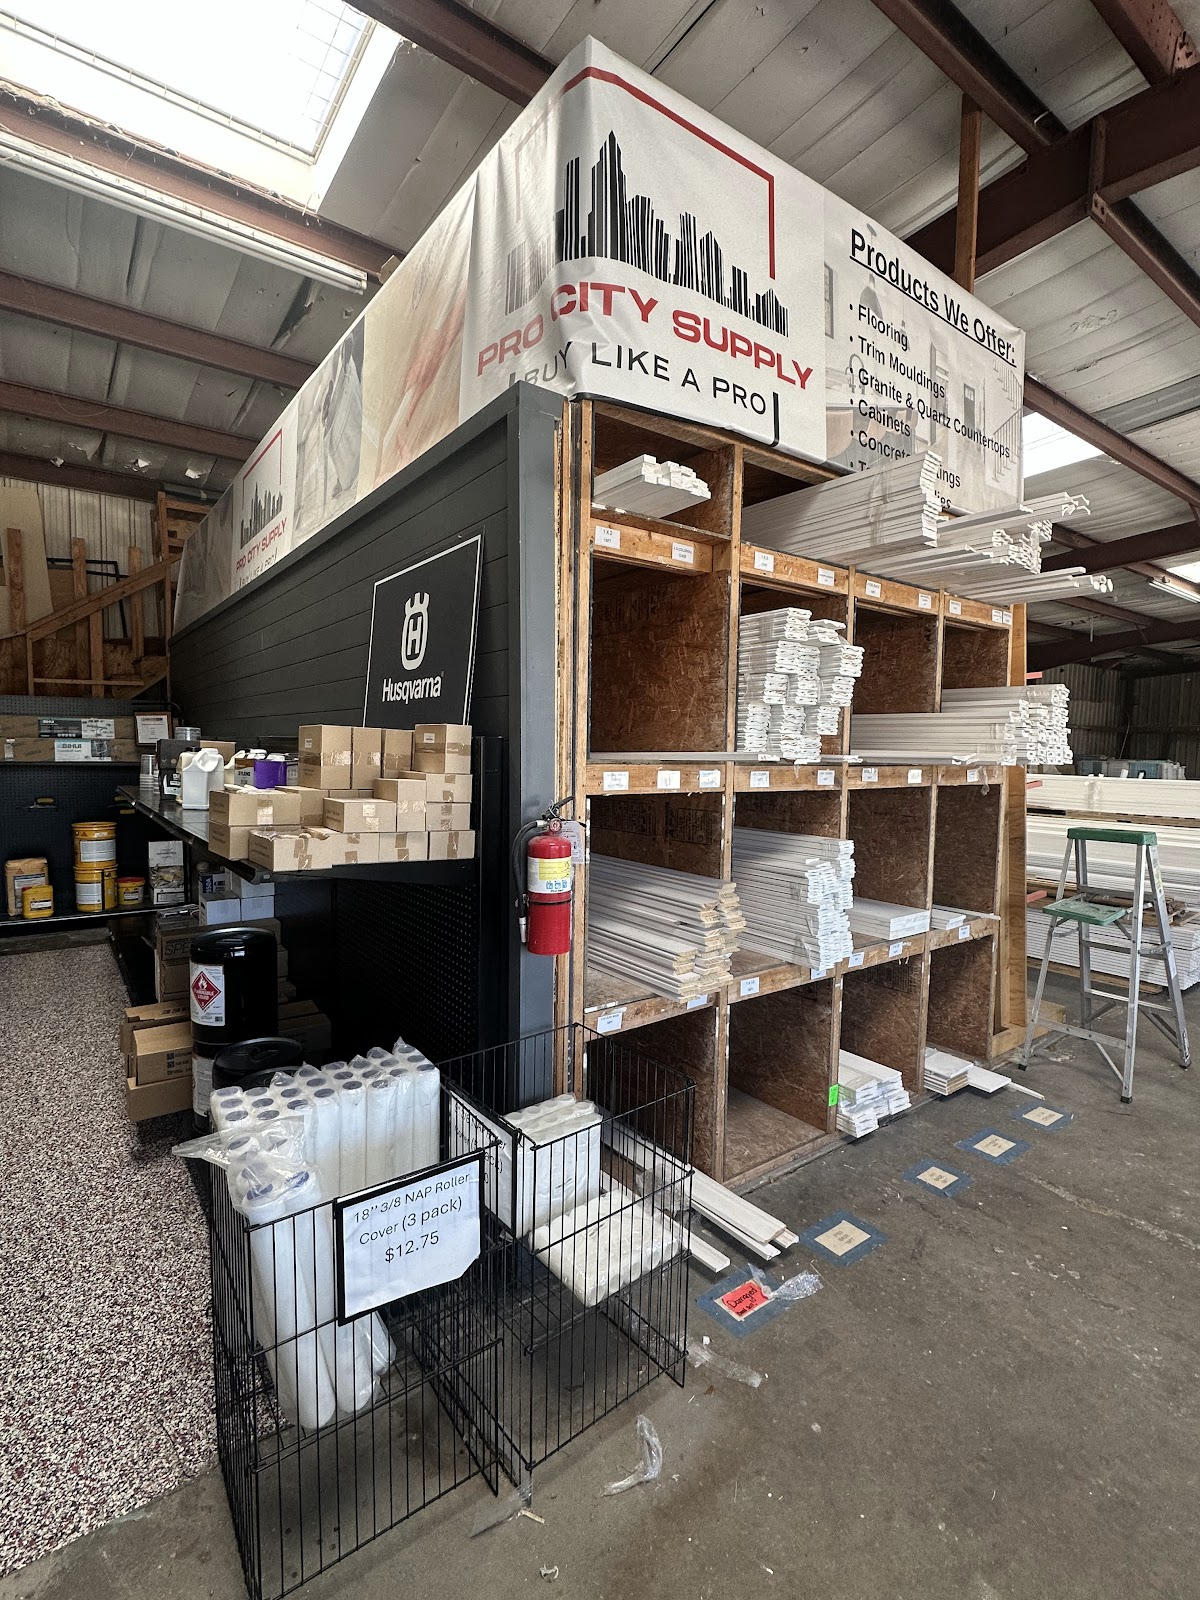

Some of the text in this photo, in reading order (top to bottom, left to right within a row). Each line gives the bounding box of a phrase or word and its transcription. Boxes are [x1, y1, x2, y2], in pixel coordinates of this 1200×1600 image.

[851, 228, 1016, 364] Products We Offer:
[477, 281, 814, 390] PRO CITY SUPPLY
[857, 303, 909, 352] Flooring
[524, 340, 767, 415] BUY LIKE A PRO
[857, 335, 946, 399] Trim Mouldings
[858, 367, 1012, 459] Granite & Quartz Countertops
[858, 399, 912, 438] Cabinets
[858, 430, 911, 461] Concret
[382, 675, 442, 705] Husqvarna
[380, 1195, 402, 1214] 3/8
[404, 1185, 433, 1205] NAP
[434, 1172, 471, 1195] Roller
[358, 1195, 463, 1246] Cover (3 pack)
[384, 1230, 440, 1264] $12.75
[726, 1286, 758, 1309] Damaged
